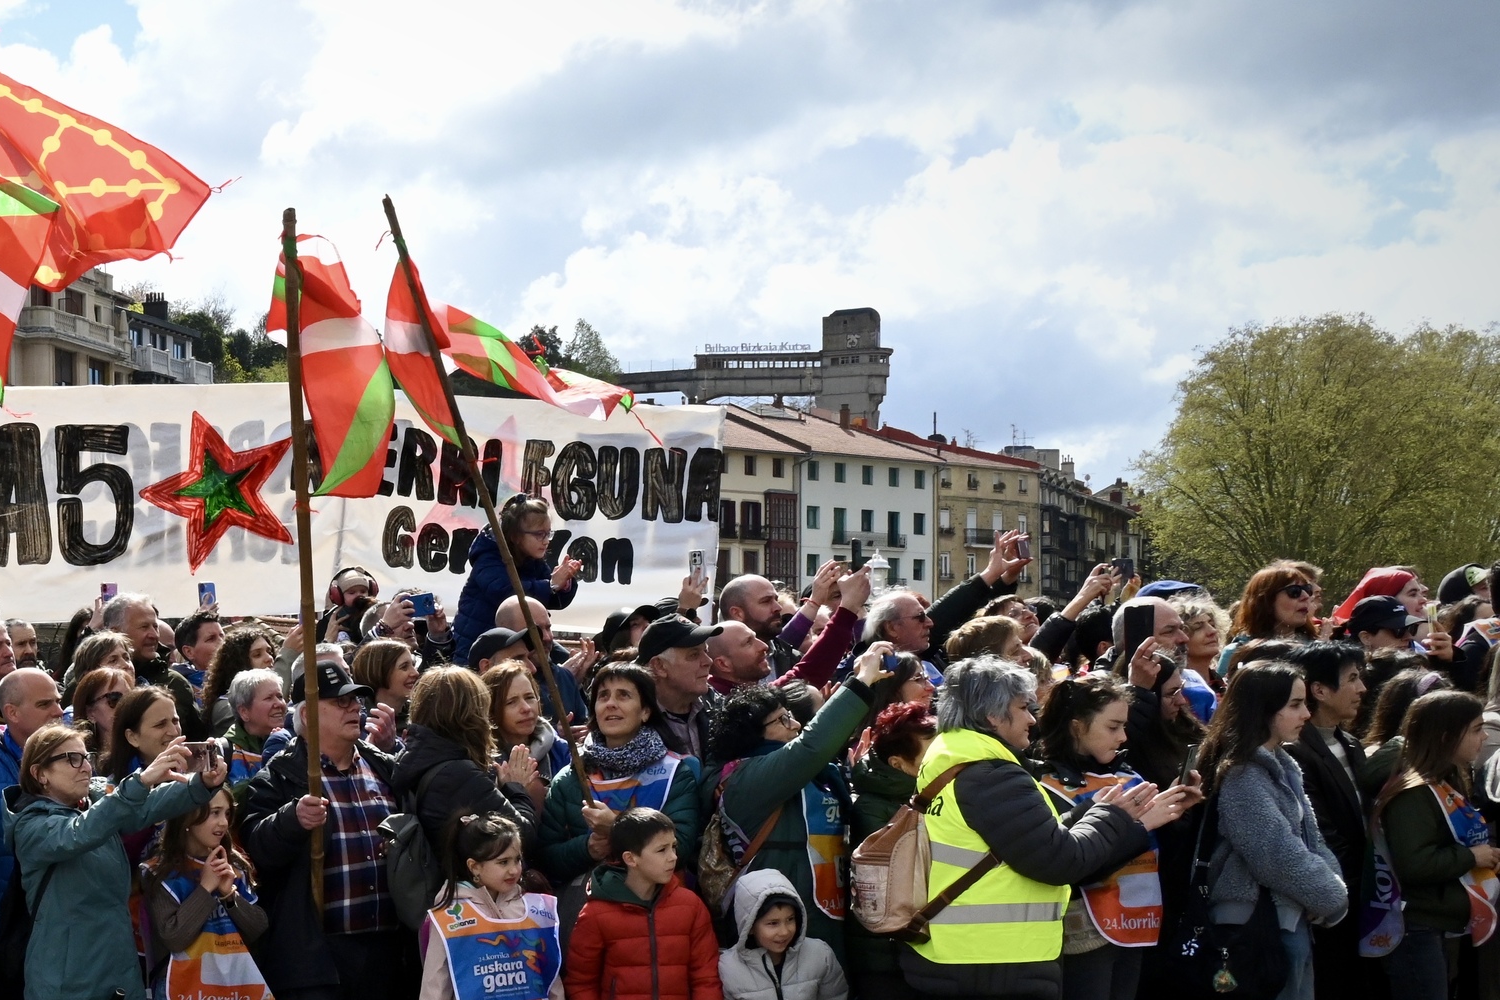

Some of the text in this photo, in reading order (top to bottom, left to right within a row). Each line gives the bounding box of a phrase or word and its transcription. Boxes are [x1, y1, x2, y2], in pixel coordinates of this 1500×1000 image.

[704, 341, 811, 353] Bilbao Bizkaia Kutxa
[473, 960, 524, 977] Euskara
[482, 970, 527, 993] gara
